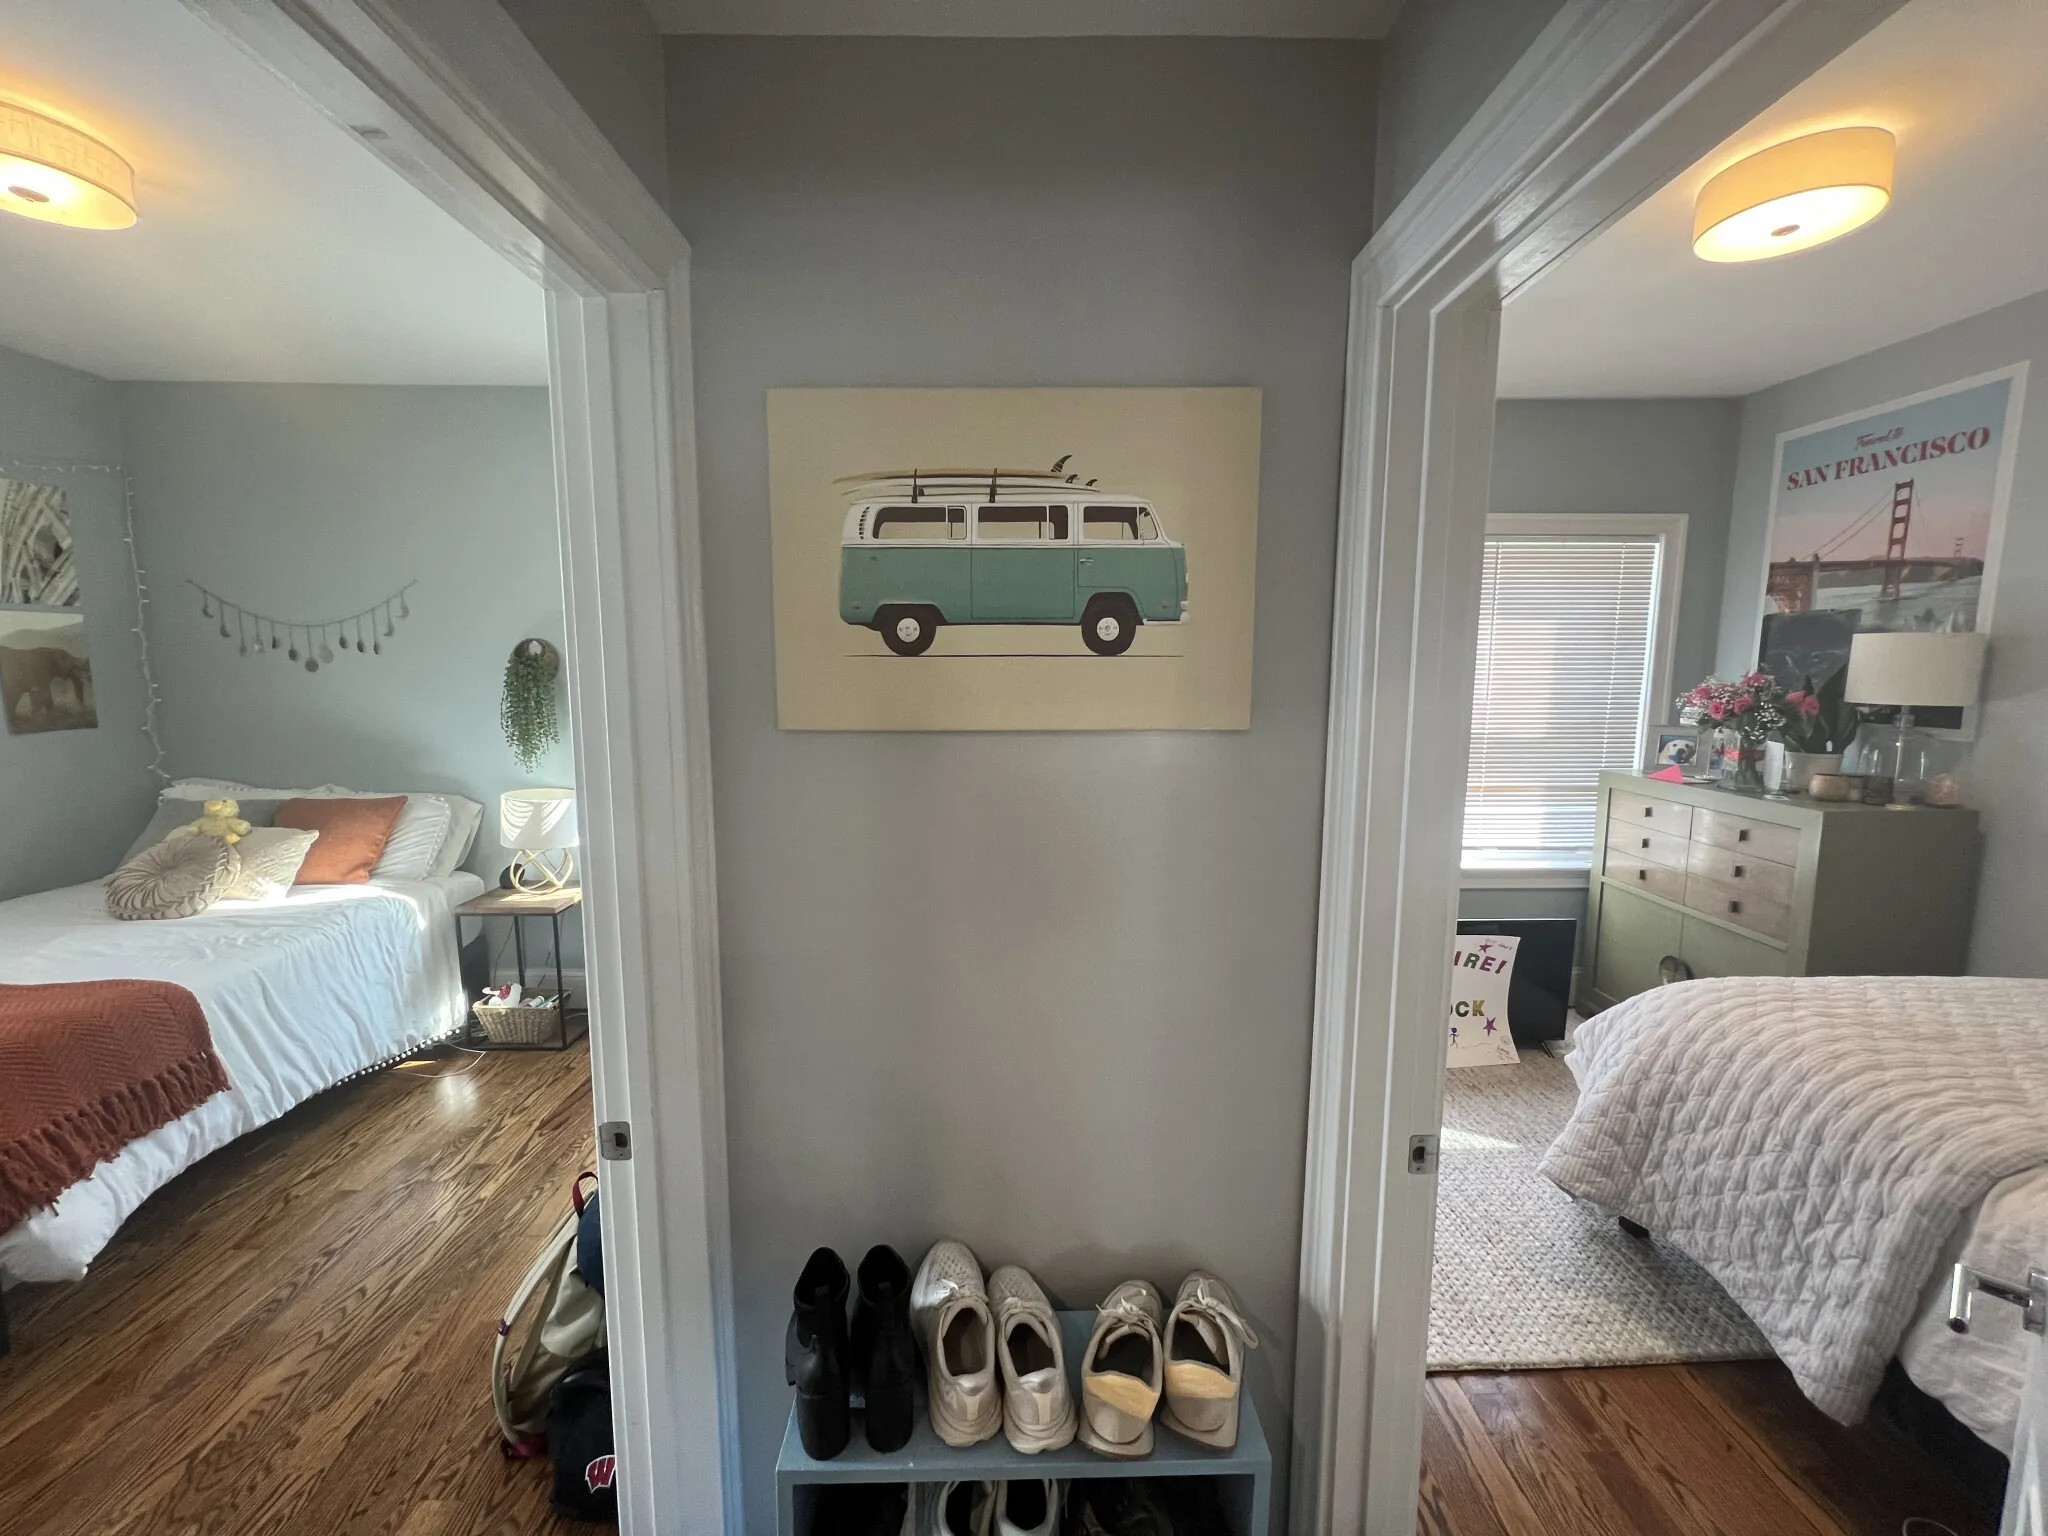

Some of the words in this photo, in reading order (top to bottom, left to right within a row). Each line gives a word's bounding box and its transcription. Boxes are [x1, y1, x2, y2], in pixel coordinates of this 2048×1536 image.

[1786, 463, 1832, 490] SAN
[1834, 426, 1991, 481] FRANCISCO
[1450, 1000, 1485, 1017] CK
